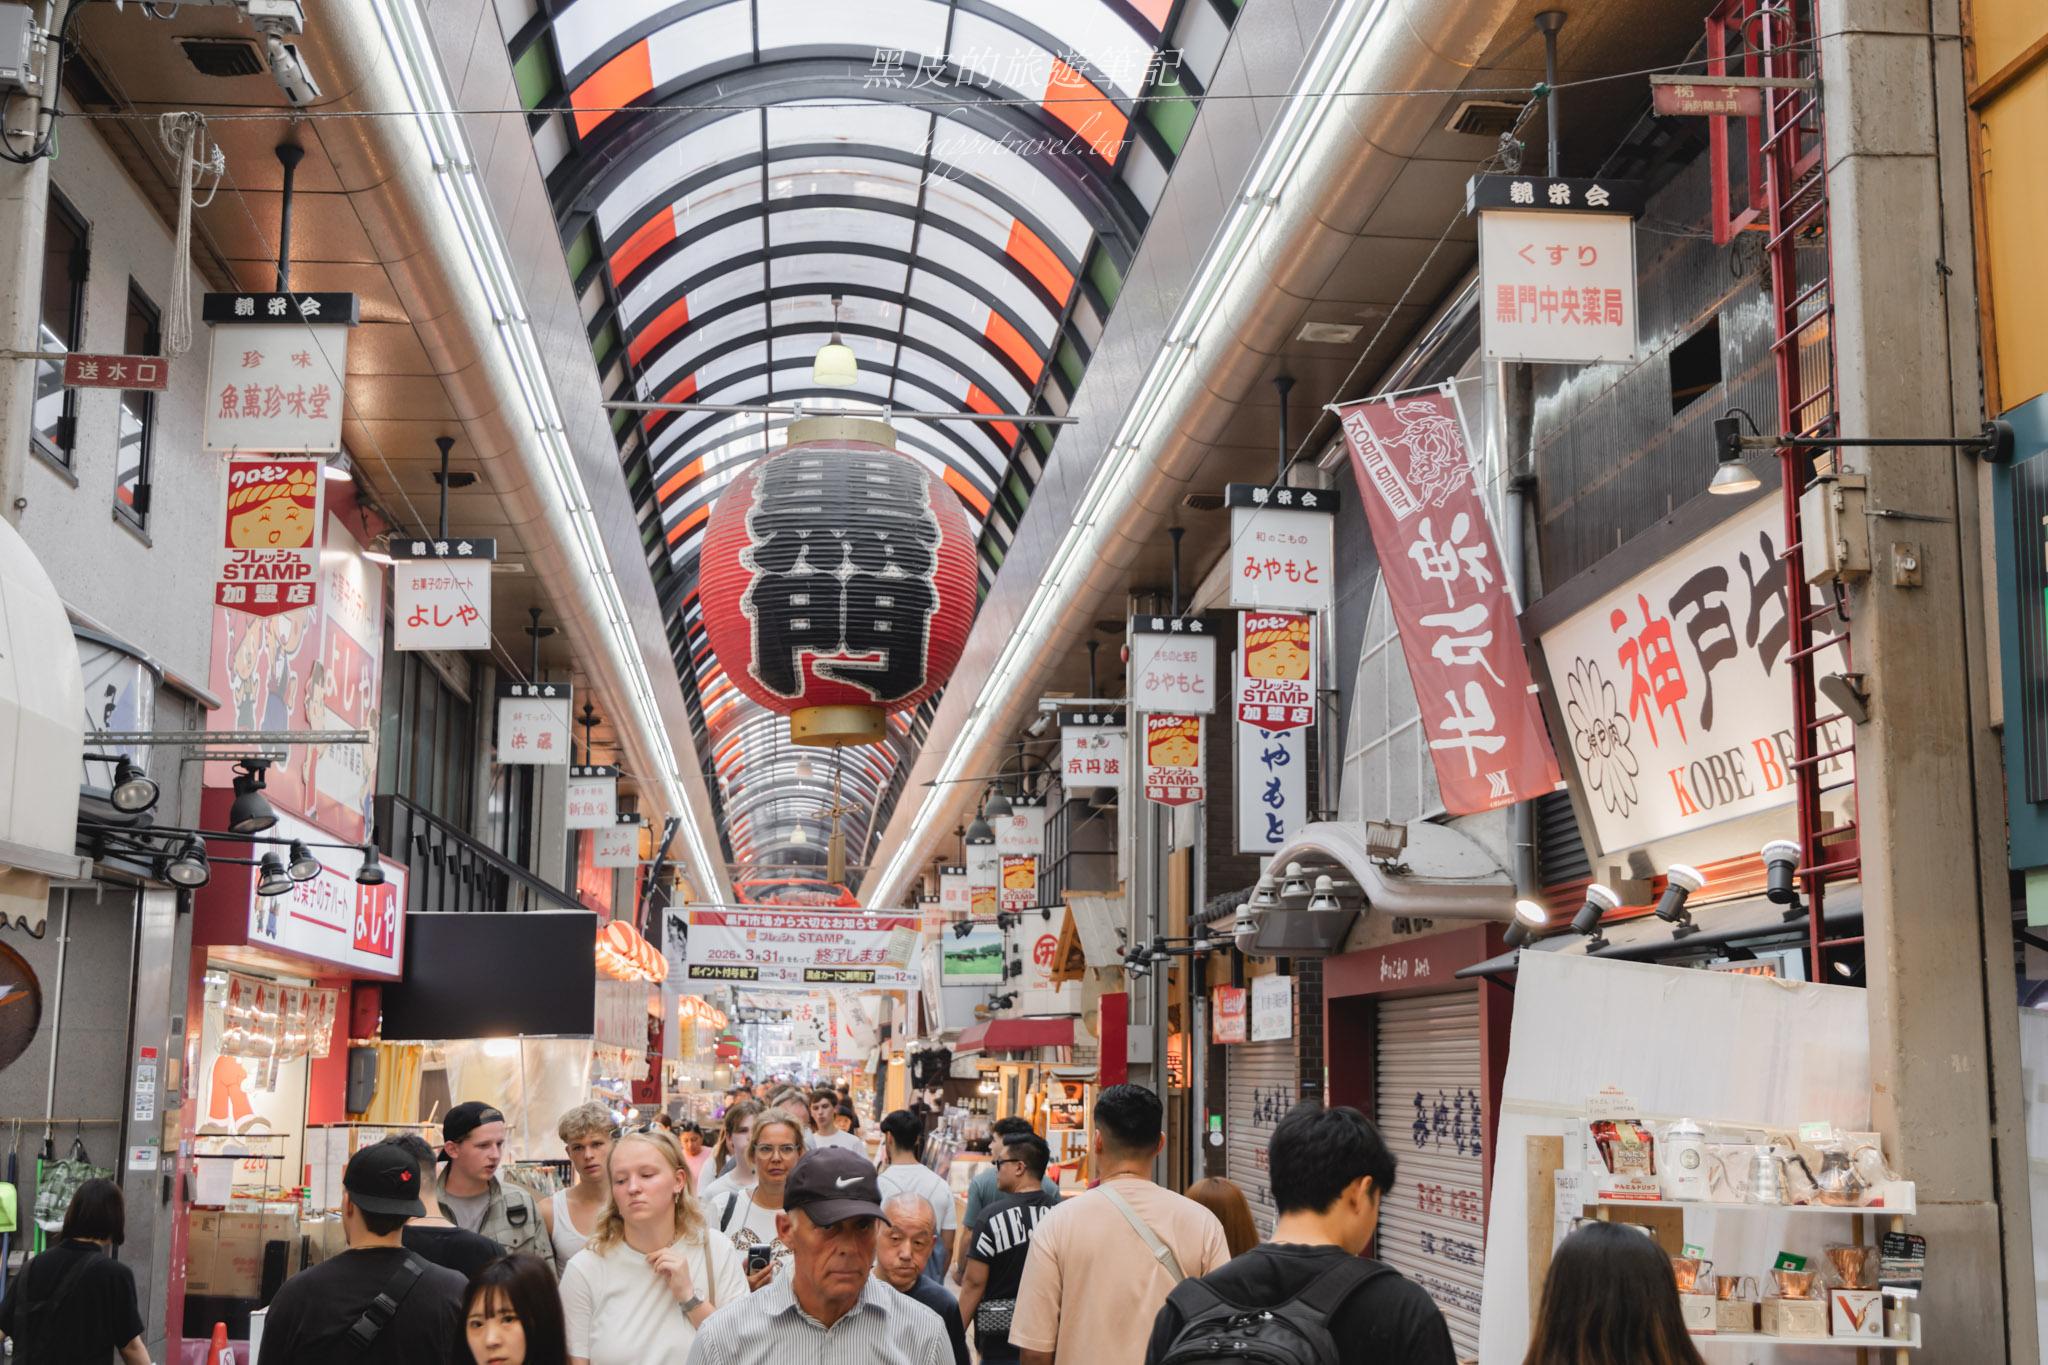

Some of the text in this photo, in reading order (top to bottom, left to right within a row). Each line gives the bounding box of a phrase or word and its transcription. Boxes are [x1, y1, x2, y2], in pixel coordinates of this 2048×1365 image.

[1510, 181, 1610, 207] 親栄会
[1518, 243, 1598, 267] くすり
[234, 296, 322, 317] 親栄会
[1496, 284, 1624, 327] 黒門中央薬局
[241, 350, 313, 369] 珍味
[78, 361, 156, 382] 送水口
[218, 383, 332, 420] 魚萬珍味堂
[230, 465, 289, 489] クロモン
[1256, 530, 1309, 545] 和のこもの
[232, 549, 302, 563] フレッシュ
[223, 564, 312, 580] STAMP
[1243, 556, 1319, 584] みやもと
[221, 583, 311, 604] 加盟店
[407, 604, 479, 628] よしや
[1246, 616, 1290, 633] クロモン
[1145, 672, 1205, 694] みやもと
[1249, 679, 1302, 692] フレッシュ
[1243, 690, 1310, 706] STAMP
[1243, 705, 1309, 723] 加盟店
[1152, 766, 1193, 776] フレッシュ
[1668, 714, 1843, 817] KOBE BEF
[1148, 775, 1200, 786] STAMP
[355, 884, 395, 950] よしや
[798, 932, 844, 943] STAMP
[976, 1206, 1027, 1257] THE
